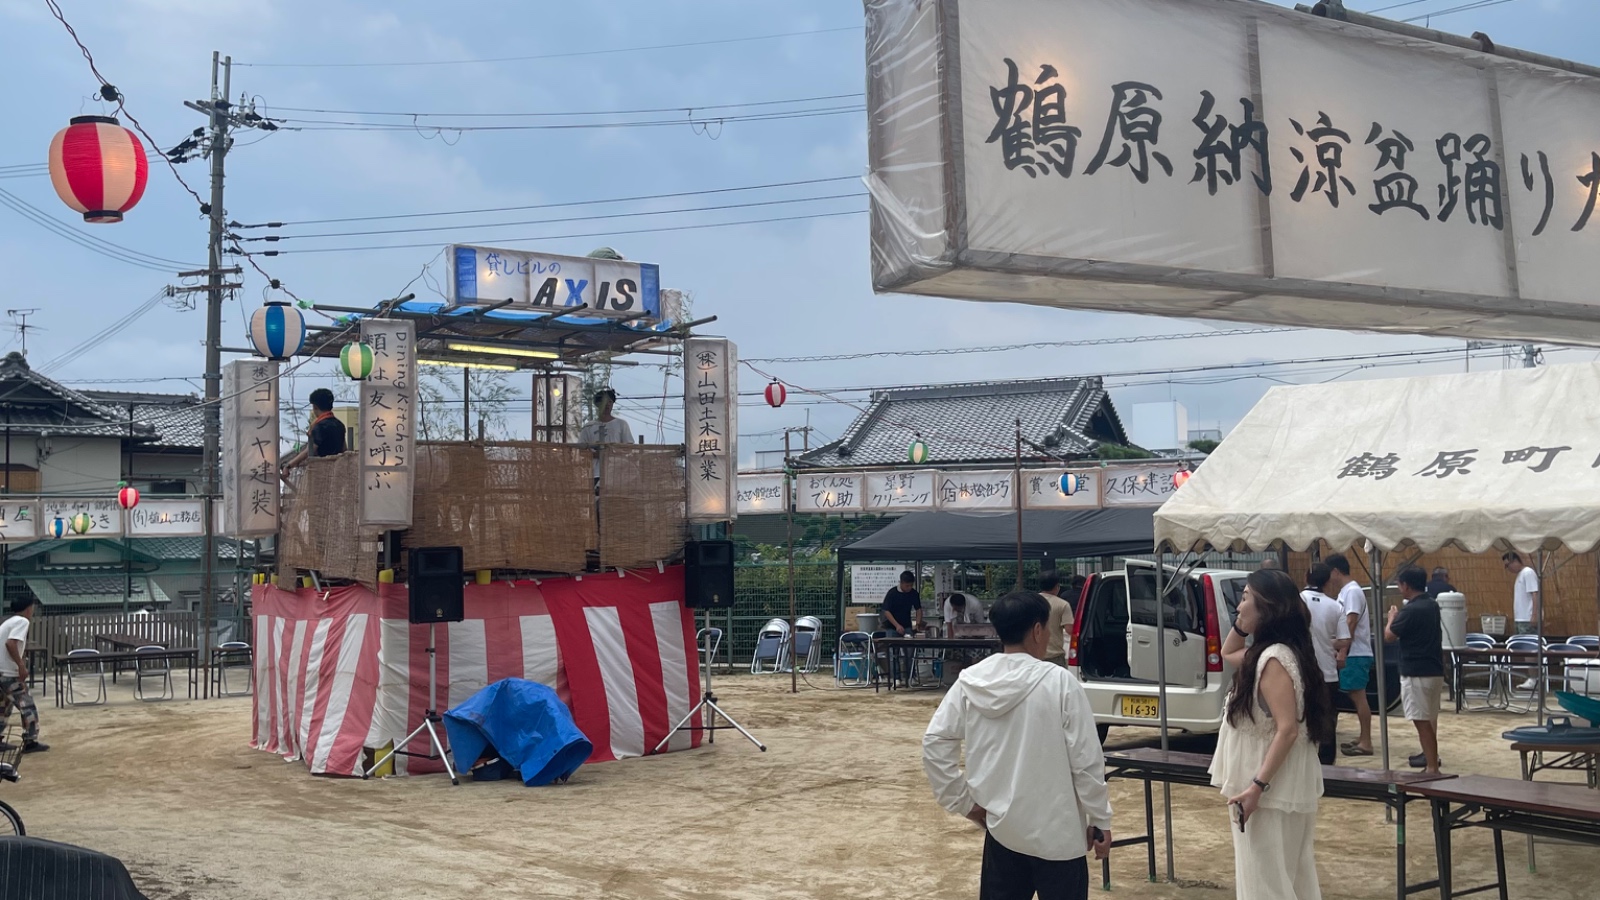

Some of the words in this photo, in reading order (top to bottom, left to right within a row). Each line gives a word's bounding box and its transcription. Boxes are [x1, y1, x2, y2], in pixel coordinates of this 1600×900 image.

[485, 252, 561, 277] 貸しビルの
[532, 277, 637, 312] AXIS
[1336, 446, 1600, 481] 鶴原町
[1030, 474, 1090, 495] 賞堂
[873, 491, 931, 507] クリーニング
[1130, 704, 1157, 716] 16-39
